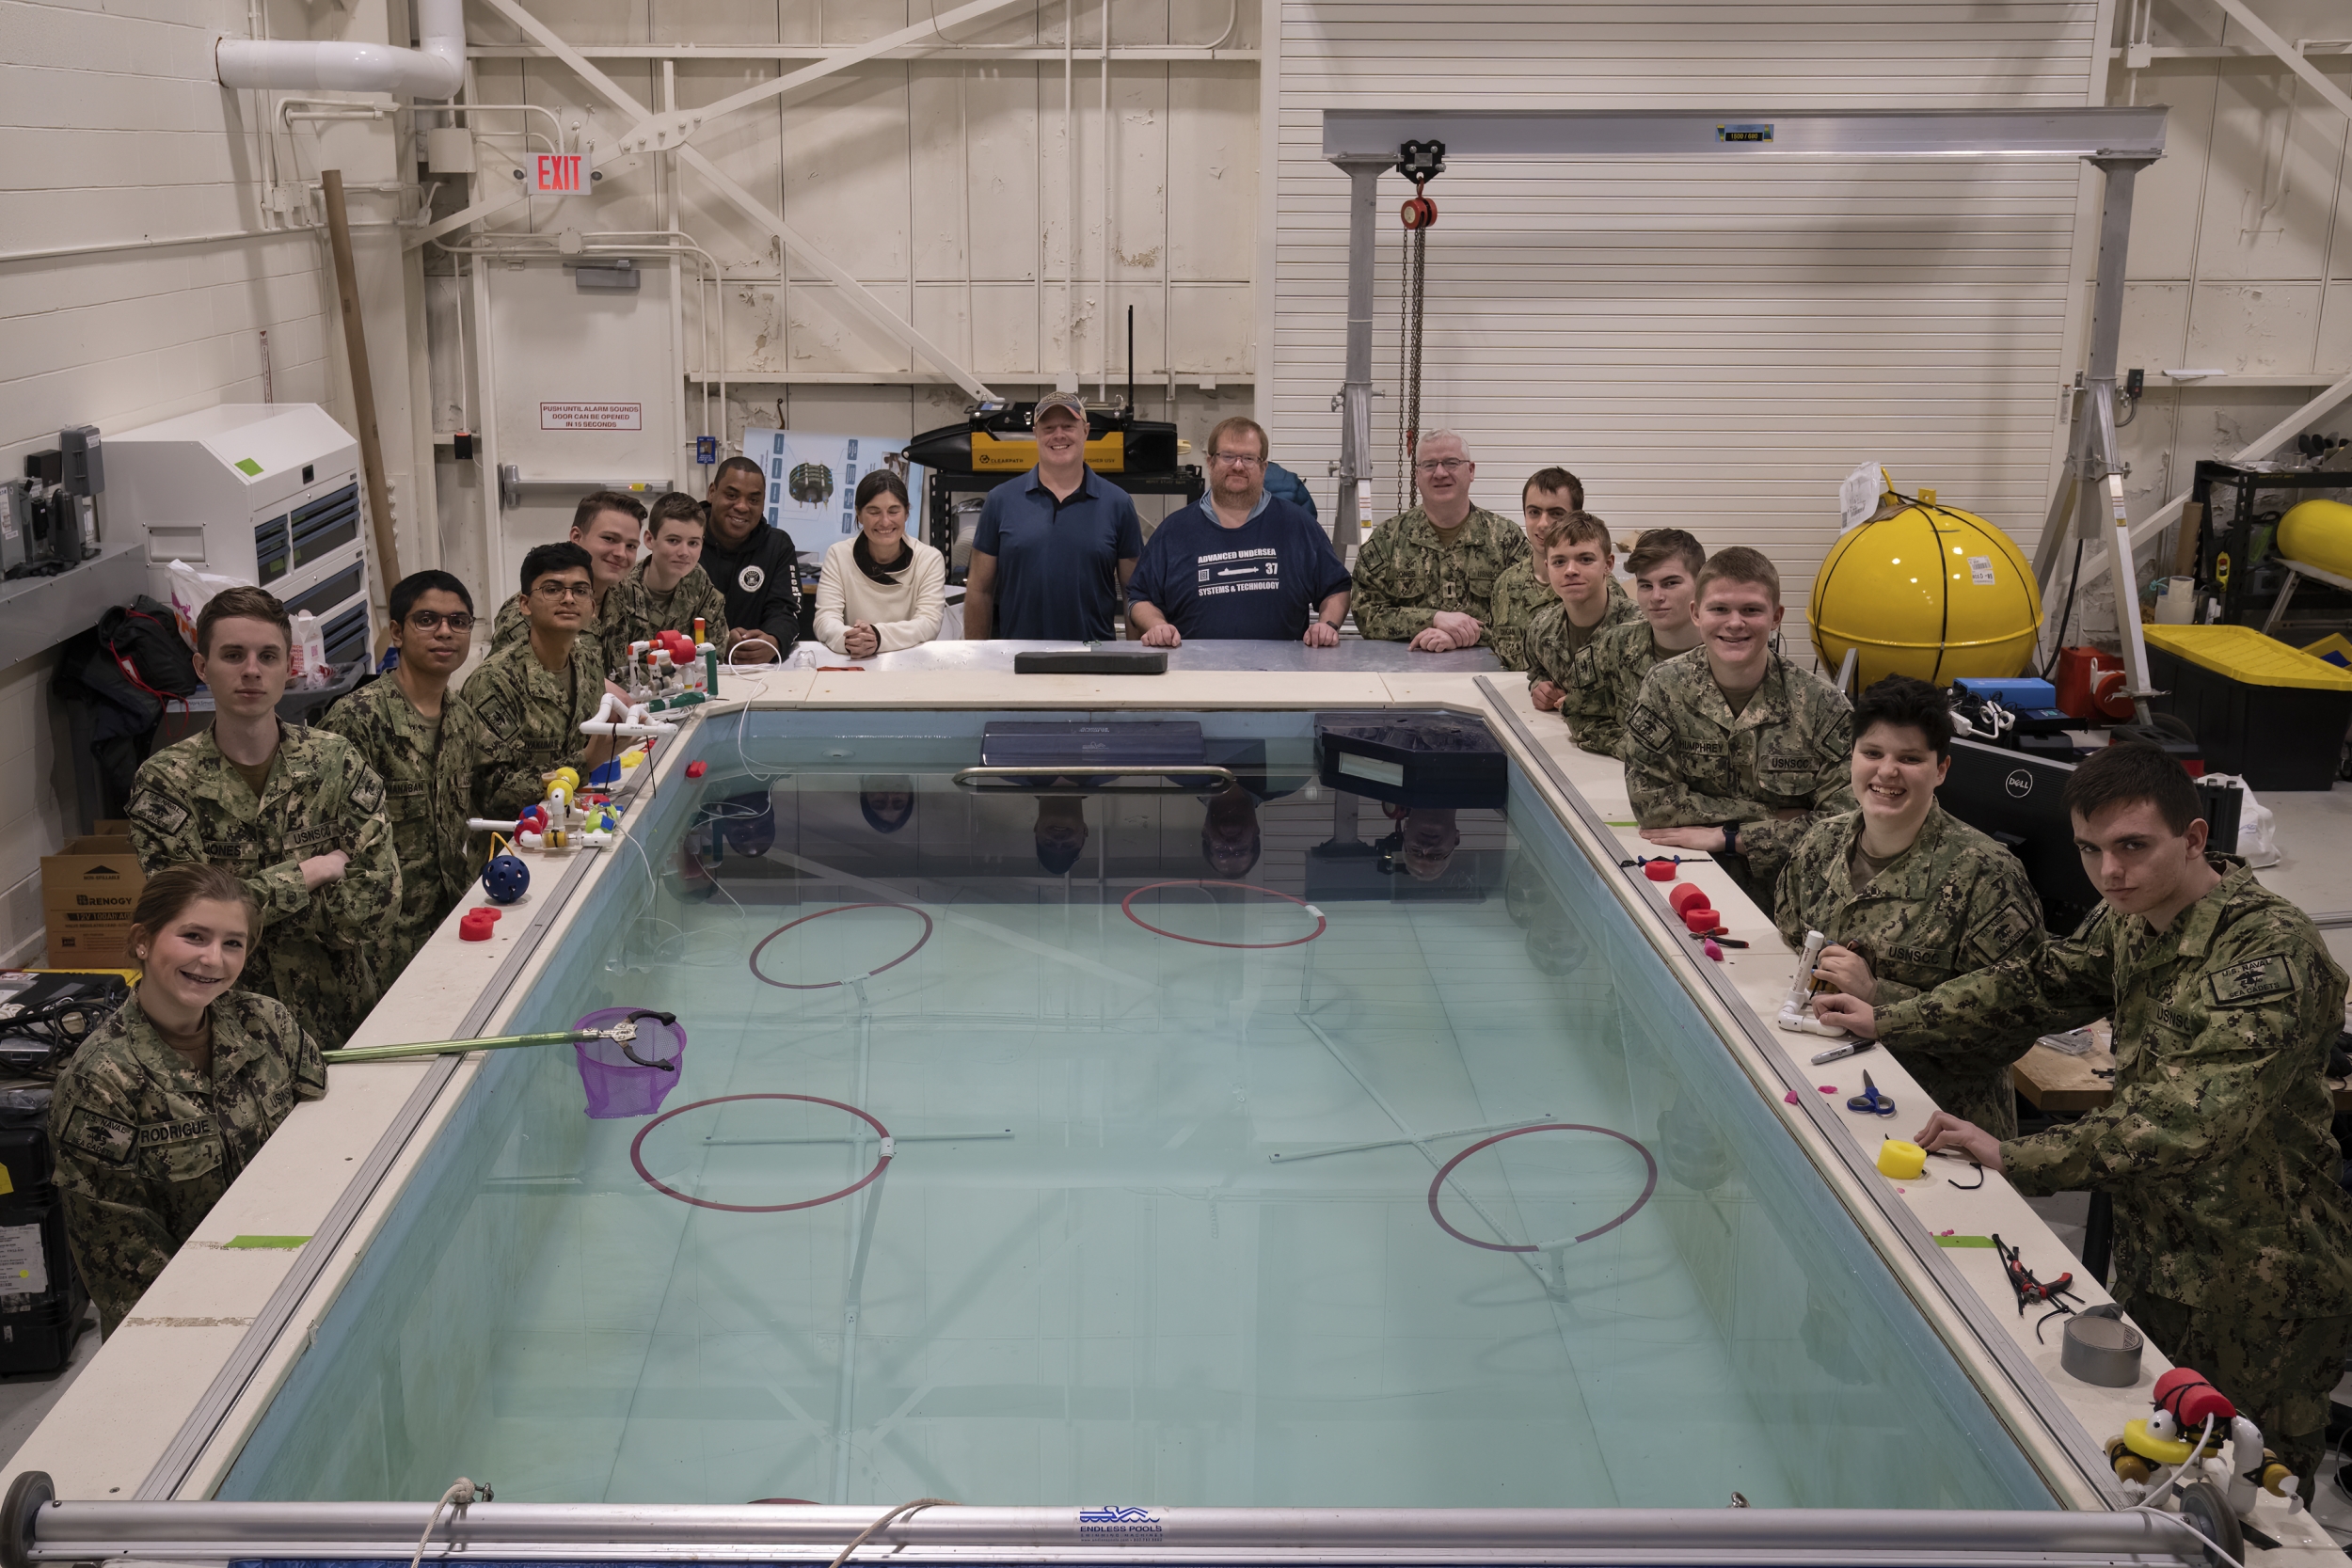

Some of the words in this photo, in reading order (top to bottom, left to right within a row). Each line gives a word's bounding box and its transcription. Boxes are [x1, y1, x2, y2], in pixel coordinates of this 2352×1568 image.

[537, 155, 581, 191] EXIT
[1198, 551, 1237, 564] ADVANCED
[1238, 547, 1277, 559] UNDERSEA
[1264, 562, 1279, 575] 37
[1395, 570, 1416, 578] JONES
[1198, 585, 1230, 597] SYSTEMS
[1236, 581, 1279, 592] TECHNOLOGY
[1679, 738, 1724, 753] HUMPHREY
[1772, 757, 1810, 769] USNSCC
[2009, 777, 2028, 789] DELL
[148, 793, 161, 802] U.S.
[161, 800, 182, 814] NAVAL
[294, 828, 331, 845] USNSCC
[205, 845, 242, 857] JONES
[89, 897, 133, 906] RENOGY
[76, 912, 91, 921] 12V
[1979, 926, 1994, 939] U.S.
[1990, 911, 2011, 929] NAVAL
[1888, 946, 1940, 965] USNSCC
[2221, 968, 2241, 977] U.S.
[2242, 958, 2273, 972] NAVAL
[2229, 989, 2246, 999] SEA
[2247, 982, 2280, 995] CADETS
[2156, 1008, 2192, 1032] USNSC
[82, 1112, 98, 1125] U.S.
[100, 1117, 126, 1134] NAVAL
[142, 1120, 210, 1144] RODRIGUE
[72, 1136, 87, 1148] SEA
[87, 1139, 115, 1158] CADETS
